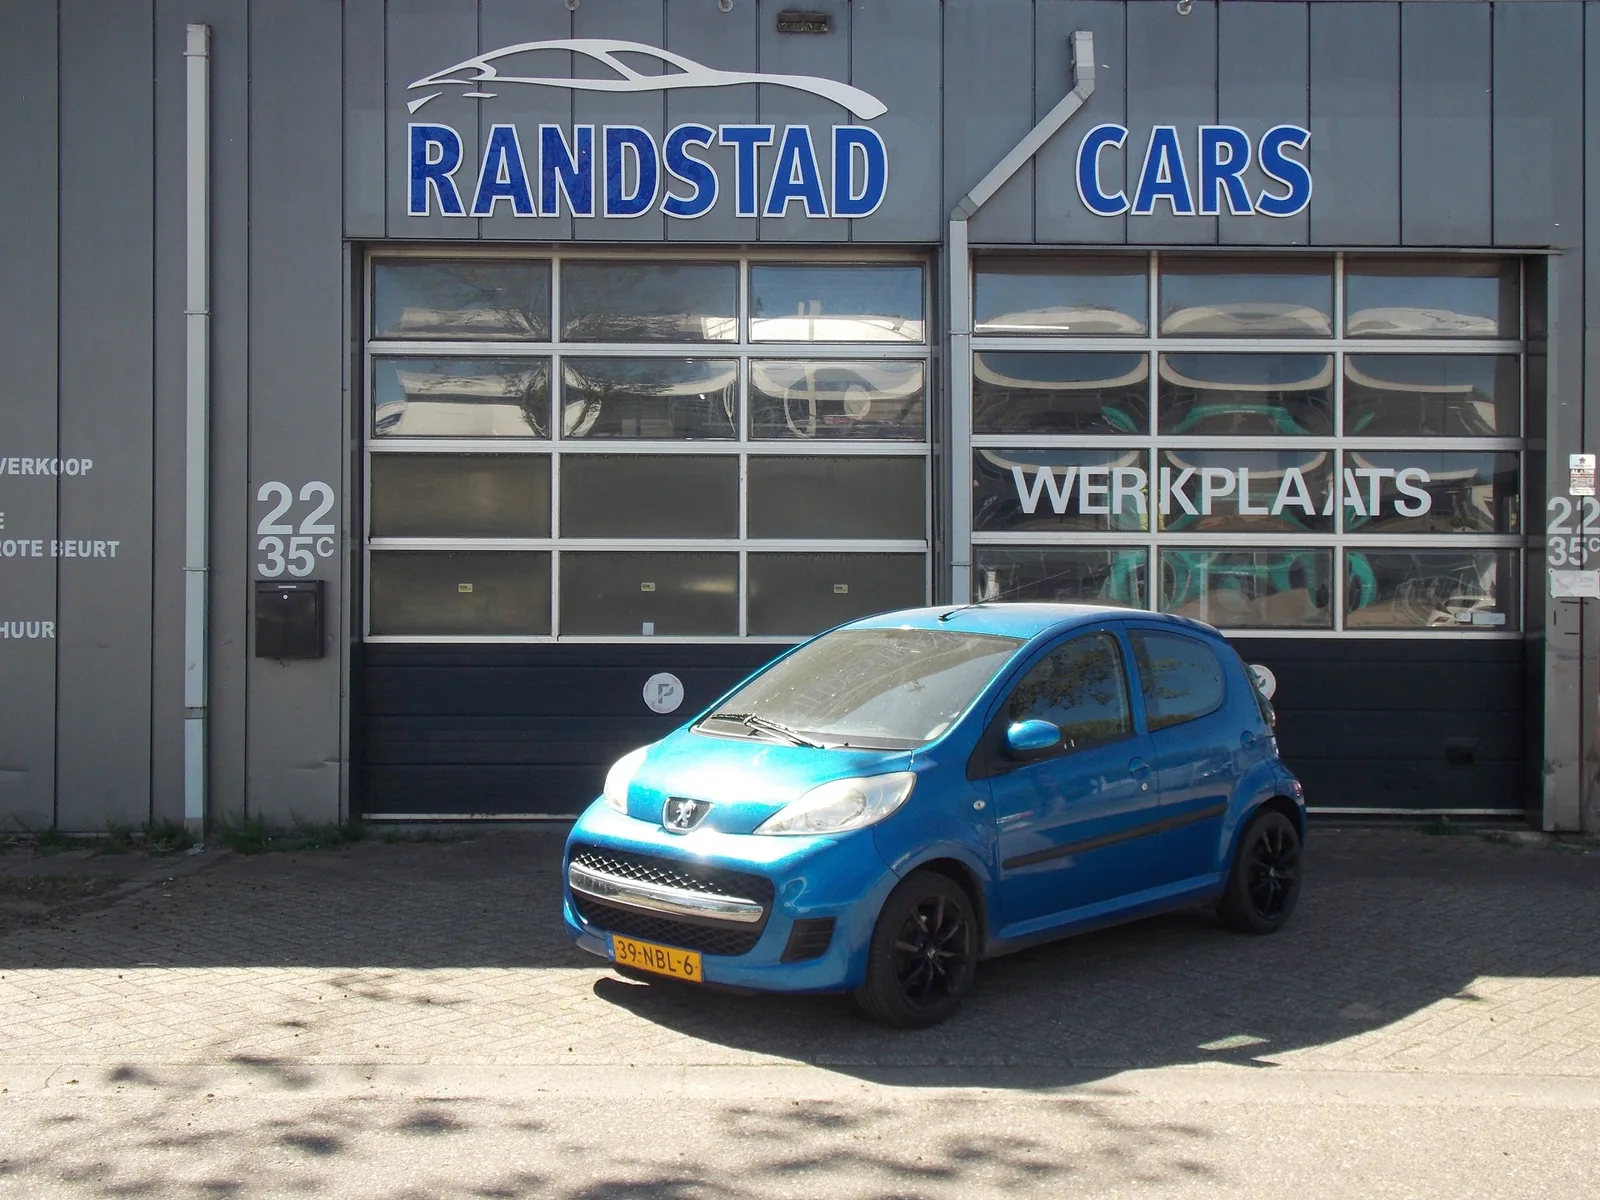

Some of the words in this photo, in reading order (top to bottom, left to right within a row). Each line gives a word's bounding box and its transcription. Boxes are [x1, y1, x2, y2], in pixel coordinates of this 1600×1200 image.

[407, 122, 889, 218] RANDSTAD
[1075, 123, 1313, 217] CARS
[257, 481, 335, 535] 22
[1011, 466, 1432, 518] WERKPLAATS
[1547, 496, 1600, 535] 22
[0, 540, 43, 557] OTE
[50, 540, 120, 558] BEURT
[617, 940, 694, 976] 39-NBL-6
